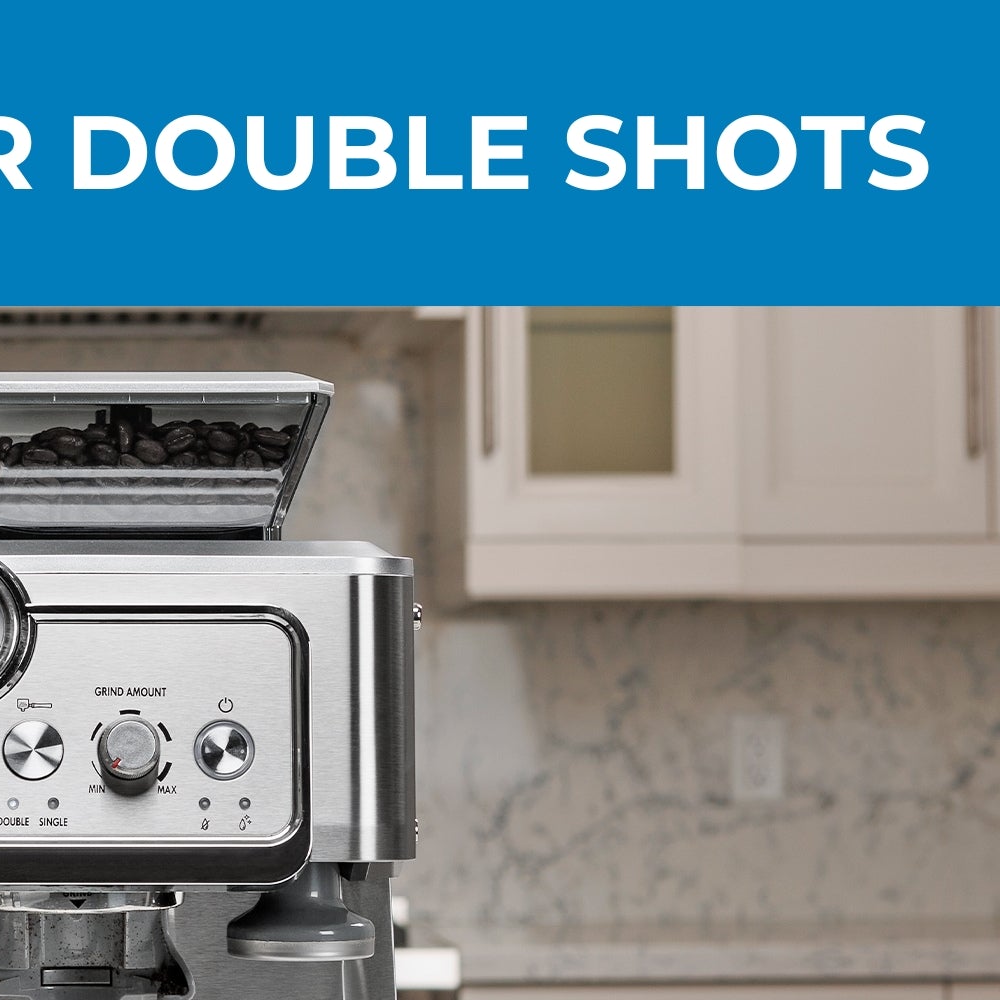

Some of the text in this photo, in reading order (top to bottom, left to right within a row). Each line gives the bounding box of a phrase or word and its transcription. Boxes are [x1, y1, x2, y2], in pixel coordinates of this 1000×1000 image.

[94, 686, 167, 698] GRIND AMOUNT
[88, 783, 178, 795] MIN MAX
[38, 816, 68, 828] SINGLE
